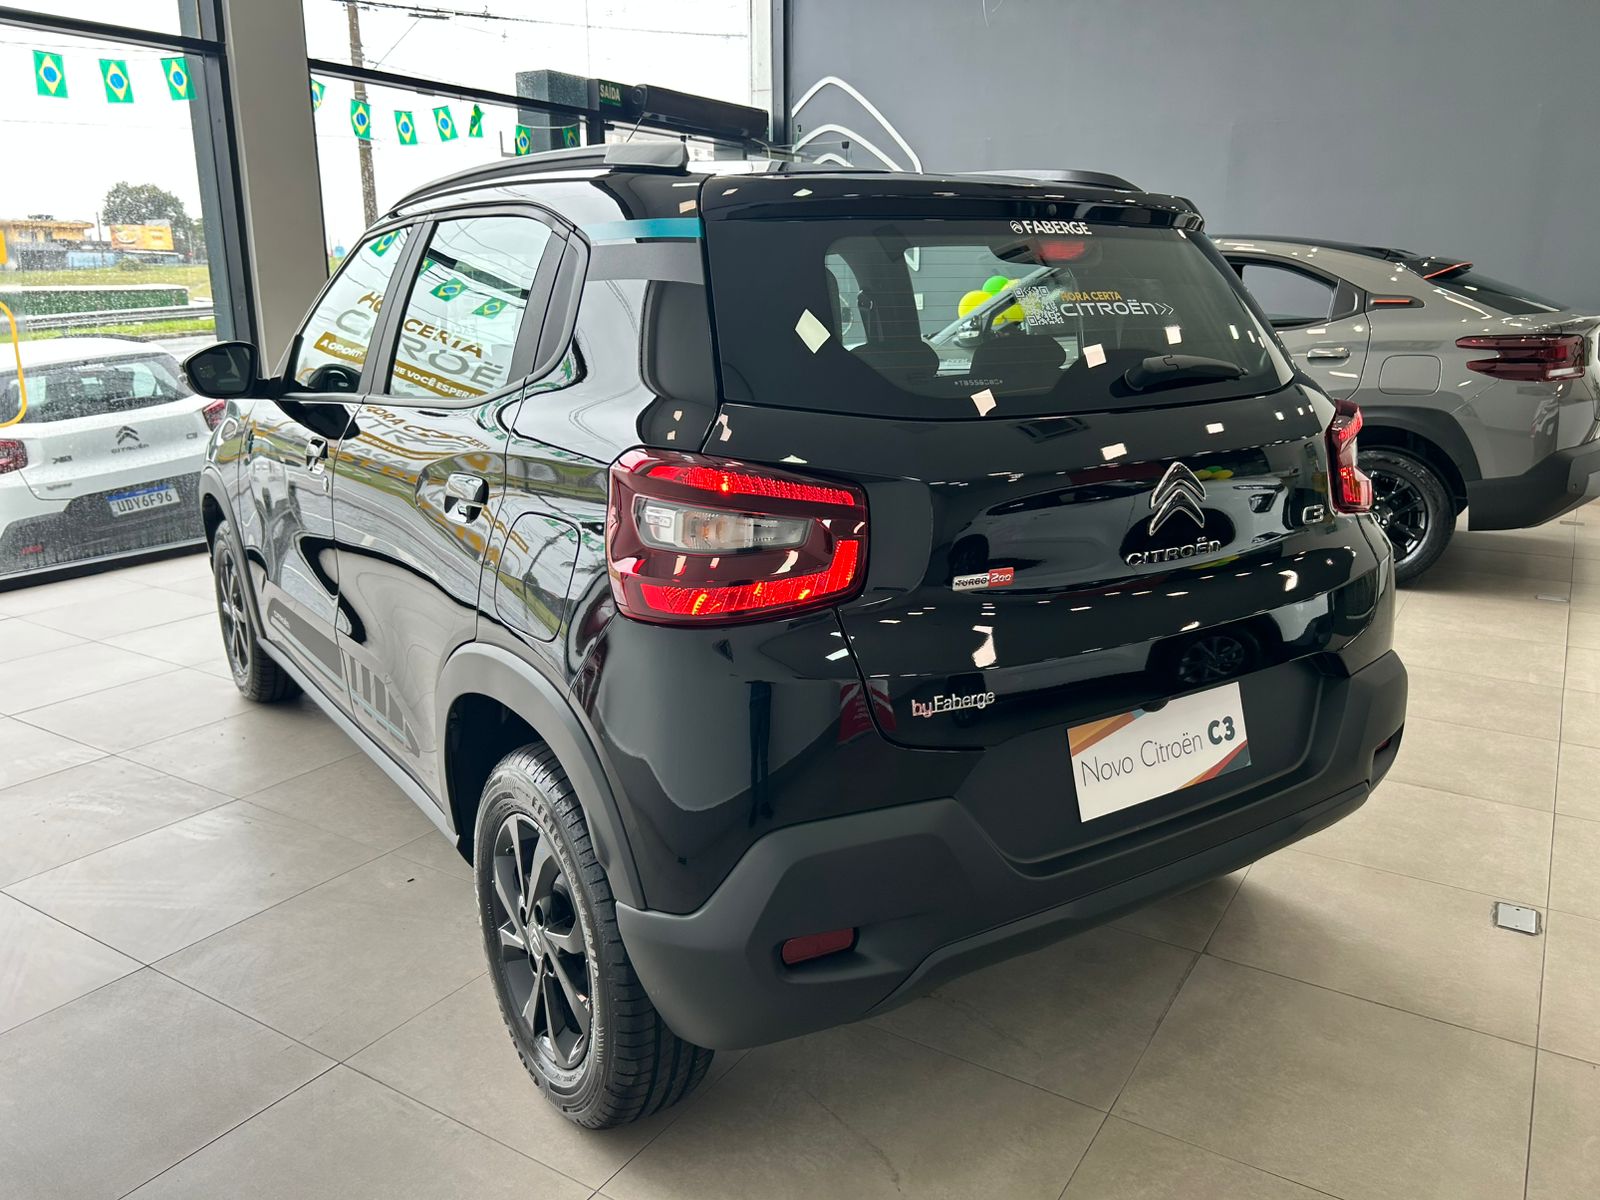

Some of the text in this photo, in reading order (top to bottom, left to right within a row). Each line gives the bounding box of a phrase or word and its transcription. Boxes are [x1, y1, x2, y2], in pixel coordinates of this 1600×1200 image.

[600, 82, 621, 101] SAÍDA
[1022, 220, 1092, 235] FABERGE
[1060, 291, 1123, 301] HORA CERTA
[407, 370, 437, 387] VOCÊ
[116, 490, 173, 512] UDY6F96
[1302, 504, 1324, 526] C3
[956, 572, 1012, 587] TURBO 200
[1080, 715, 1237, 787] Novo Citroën C3
